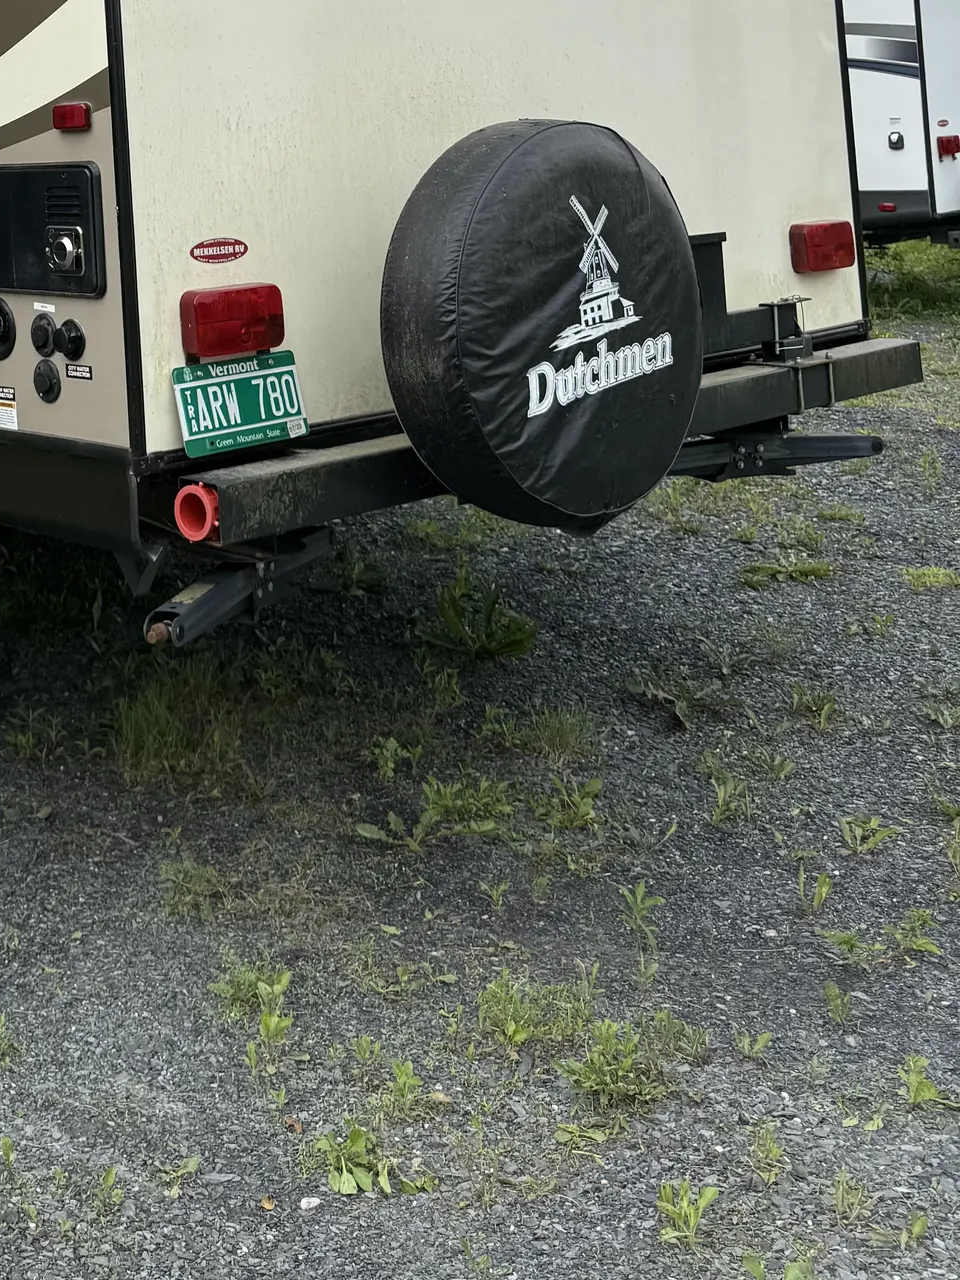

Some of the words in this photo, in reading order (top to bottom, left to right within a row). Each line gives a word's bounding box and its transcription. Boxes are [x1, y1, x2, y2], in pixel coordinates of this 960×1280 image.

[193, 246, 234, 257] MEKKELSEN
[234, 244, 245, 253] RV
[207, 358, 259, 378] Vermont
[526, 331, 674, 418] Dutchmen
[196, 382, 242, 432] ARW
[251, 373, 298, 420] 780
[215, 438, 234, 448] Green
[236, 432, 265, 444] Mountain
[266, 428, 281, 438] State
